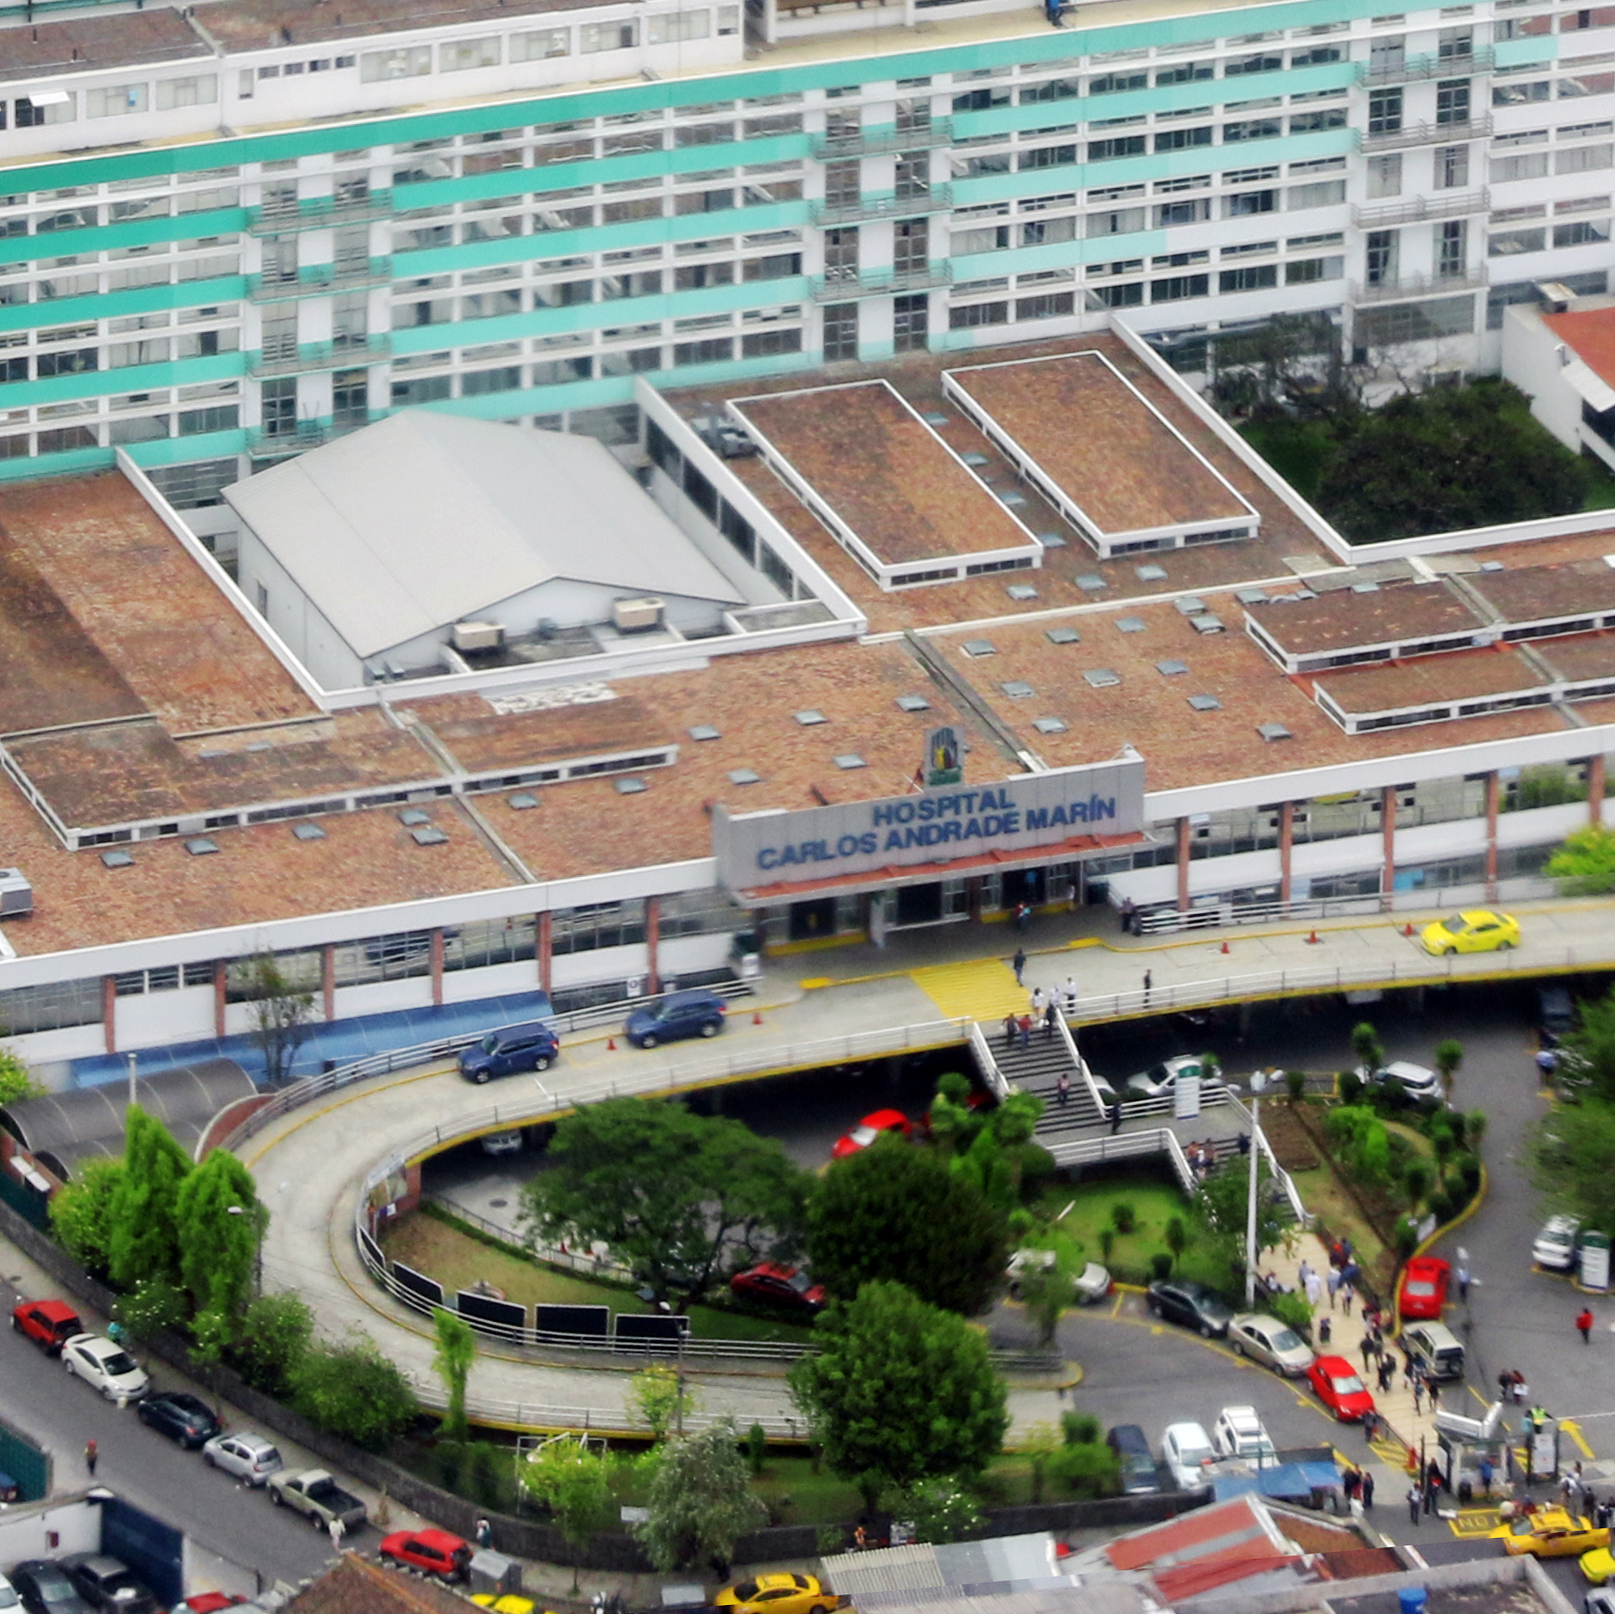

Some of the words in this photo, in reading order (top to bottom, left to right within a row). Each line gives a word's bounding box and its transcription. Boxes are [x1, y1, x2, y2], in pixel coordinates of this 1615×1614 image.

[757, 832, 878, 871] CARLOS
[883, 811, 1021, 852] ANDRADE
[1026, 793, 1117, 831] MARÍN
[872, 788, 1016, 827] HOSPITAL
